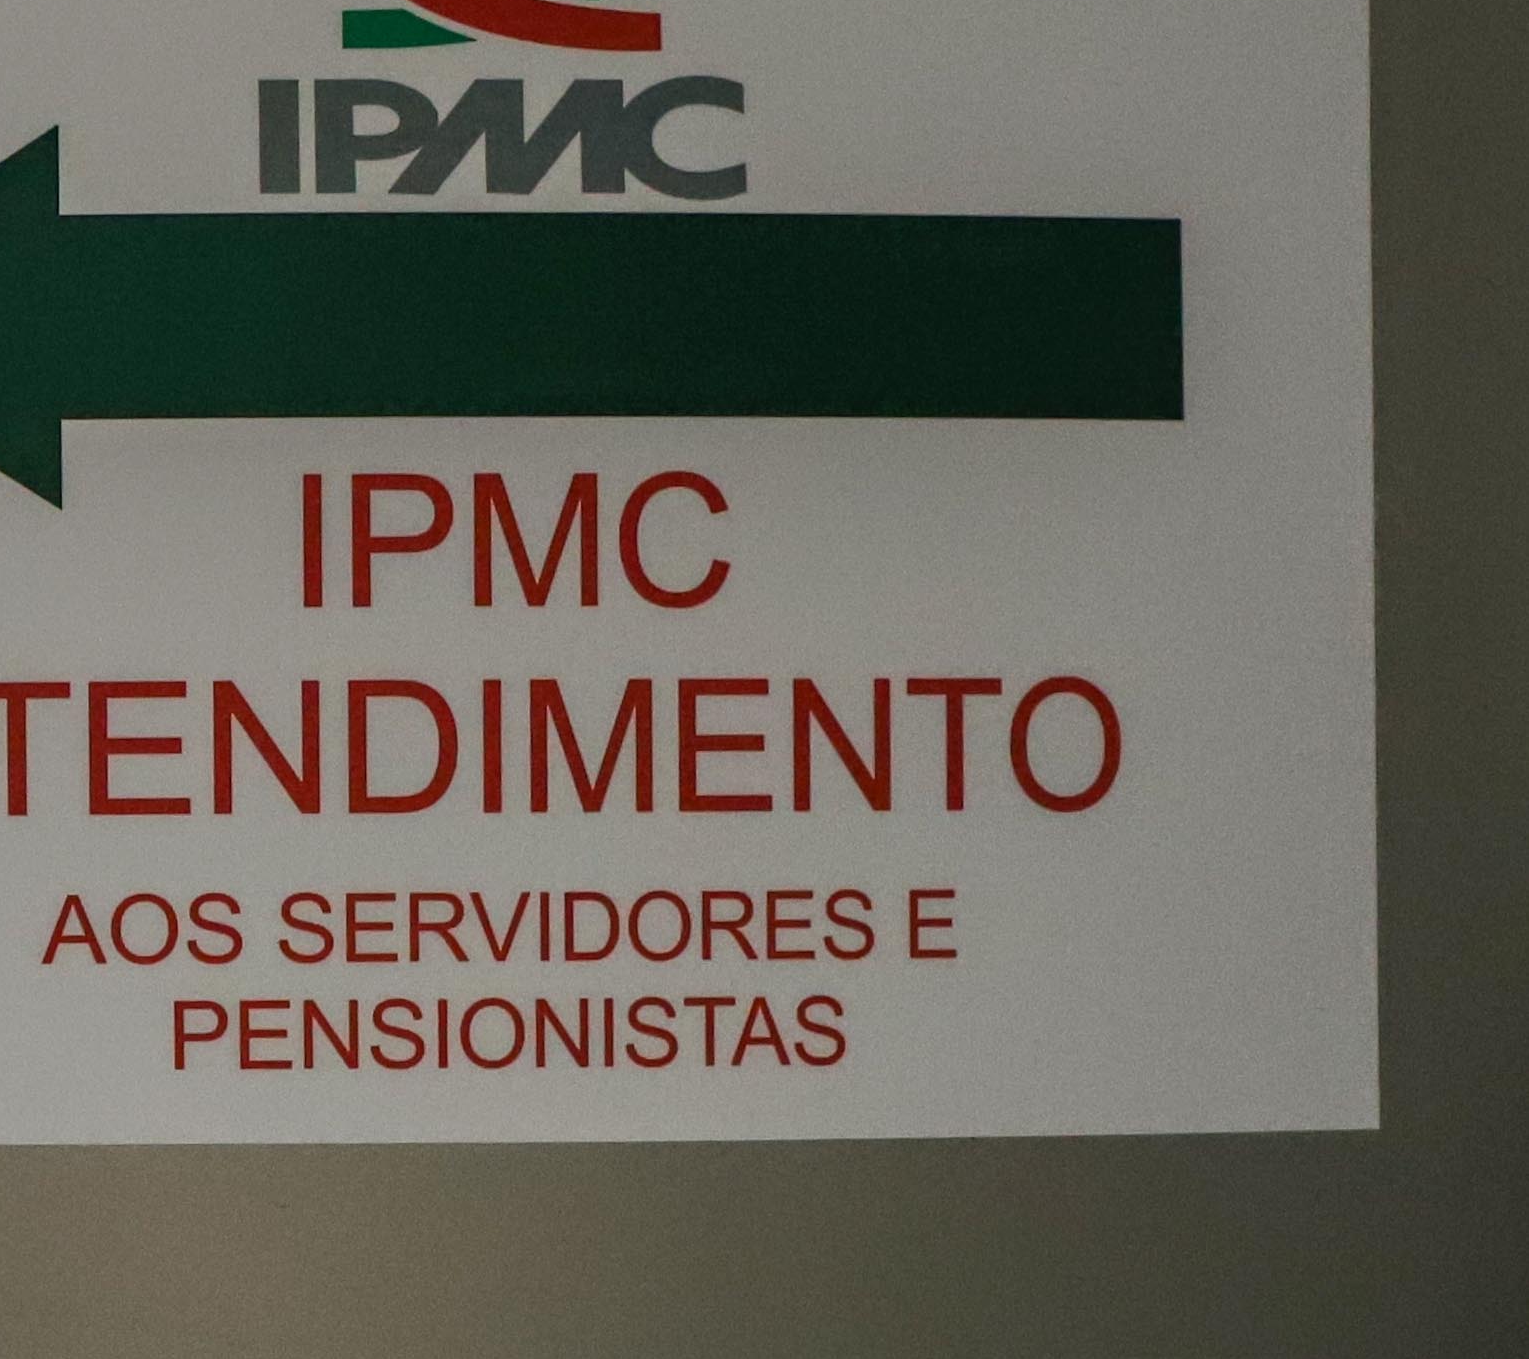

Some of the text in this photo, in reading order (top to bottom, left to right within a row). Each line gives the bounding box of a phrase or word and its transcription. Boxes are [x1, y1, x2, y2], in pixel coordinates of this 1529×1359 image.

[258, 75, 749, 202] IPMC
[302, 472, 731, 609] IPMC
[41, 888, 958, 966] AOS SERVIDORES E
[173, 994, 847, 1071] PENSIONISTAS
